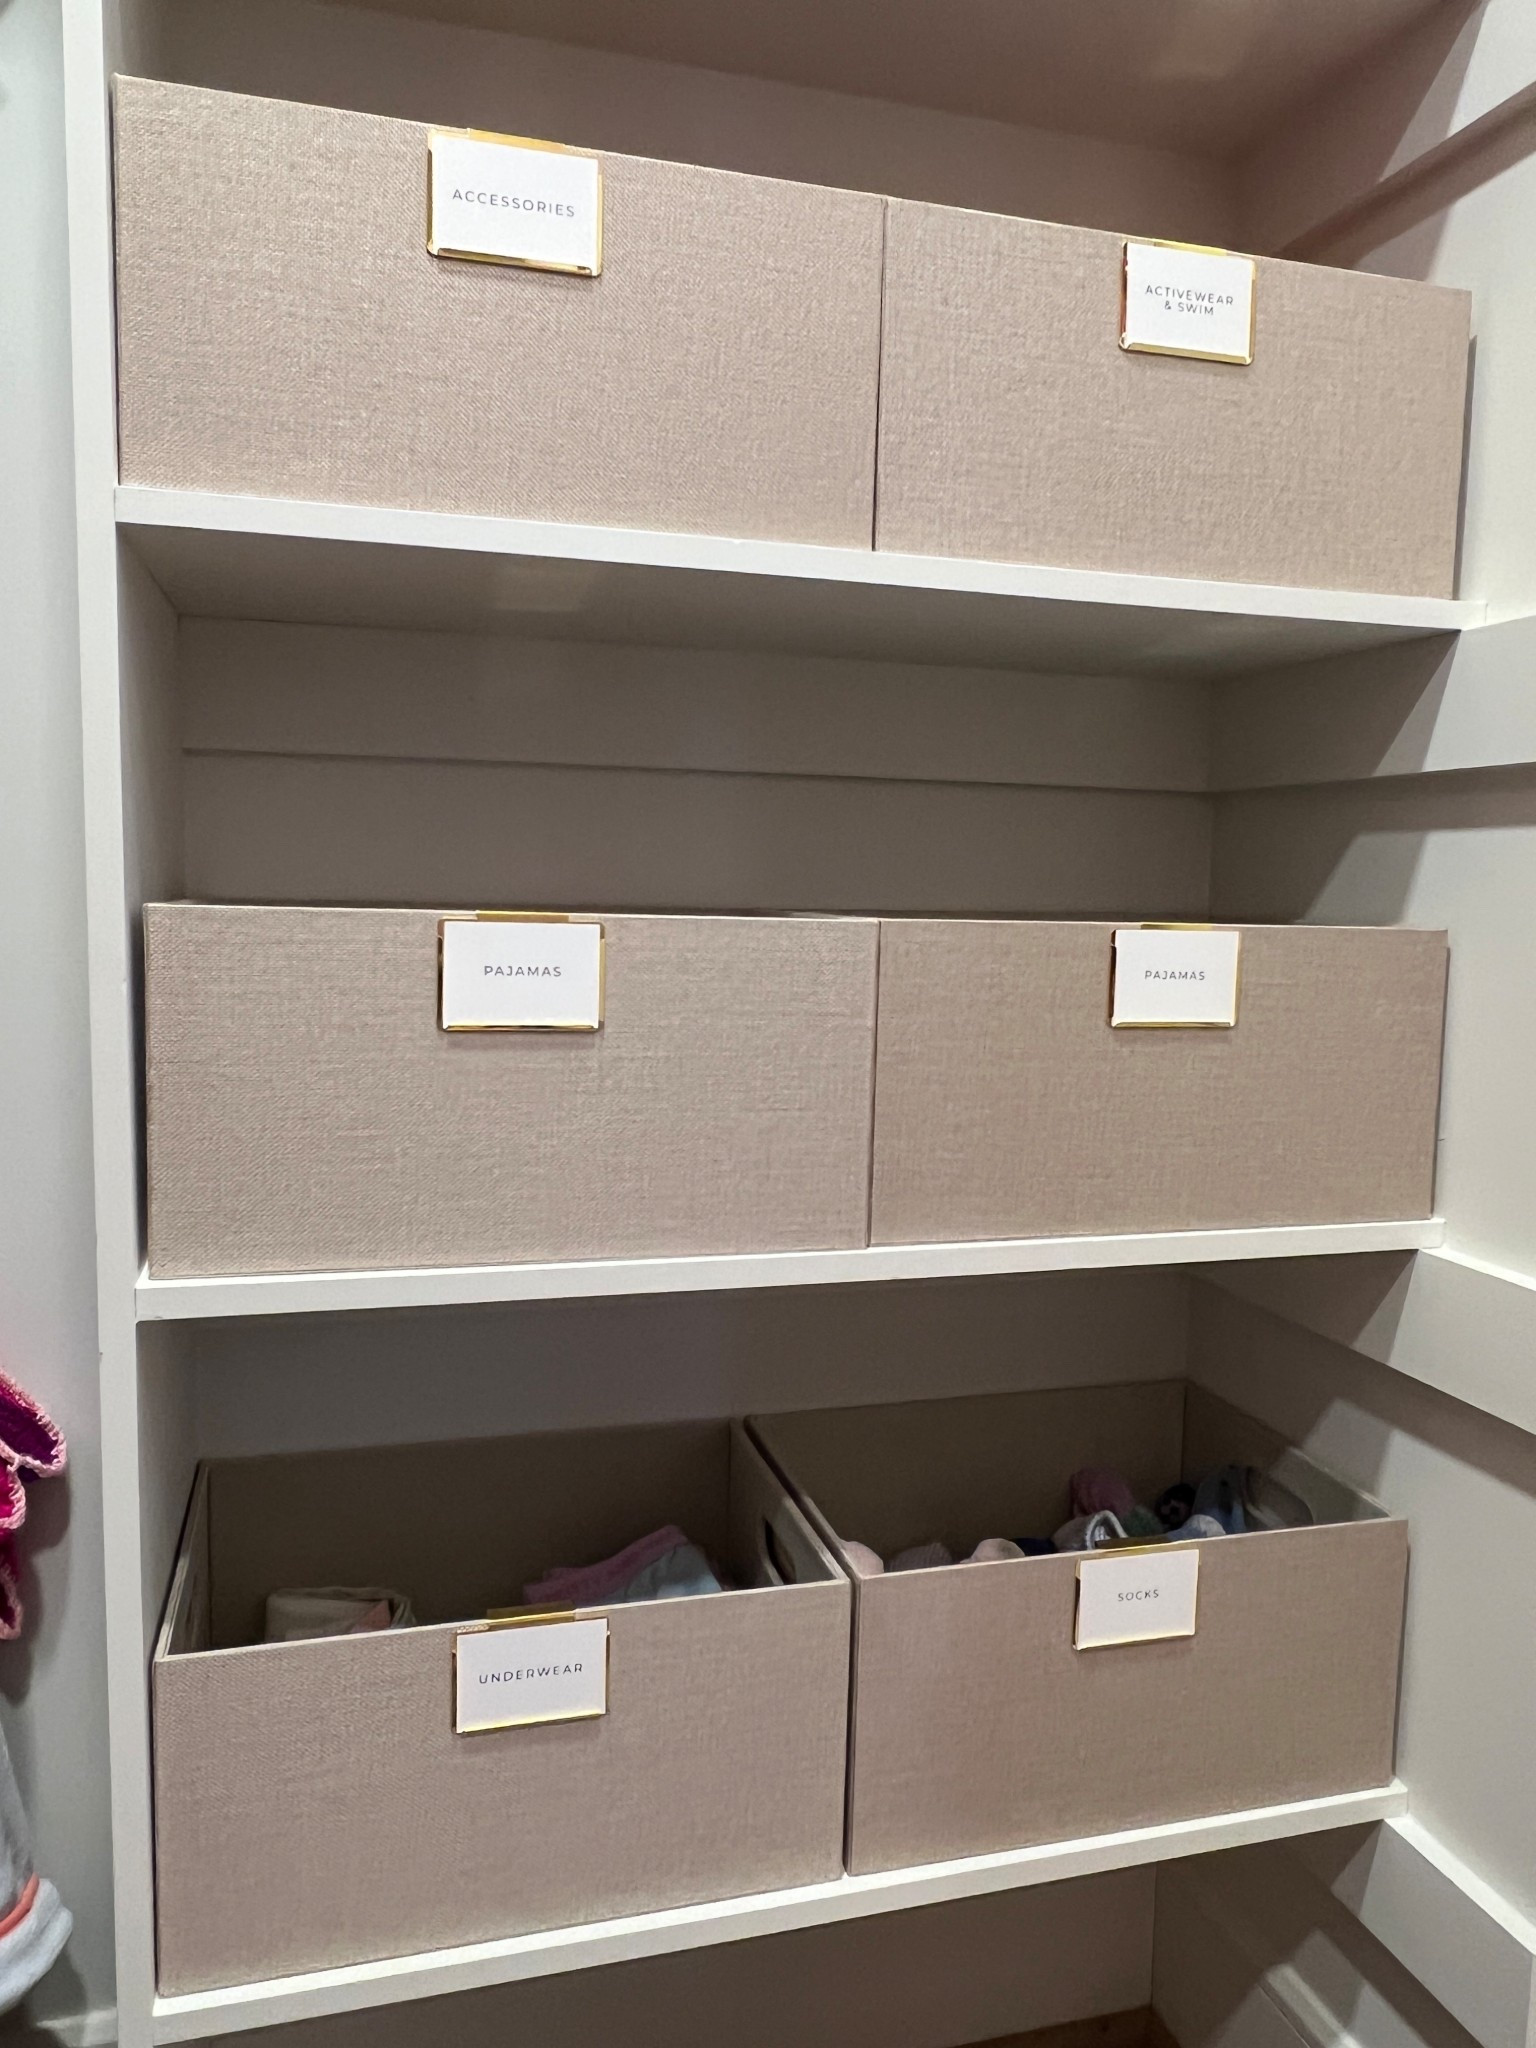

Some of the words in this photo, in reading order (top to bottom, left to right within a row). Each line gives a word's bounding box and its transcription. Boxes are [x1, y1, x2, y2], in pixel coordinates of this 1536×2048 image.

[452, 188, 575, 218] ACCESSORIES
[1144, 284, 1234, 306] ACTIVEWEAR
[1164, 299, 1172, 311] &
[1177, 301, 1214, 316] SWIM
[483, 965, 563, 978] PAJAMAS
[1144, 969, 1206, 980] PAJAMAS
[1117, 1588, 1160, 1602] SOCKS
[478, 1663, 583, 1685] UNDERWEAR
